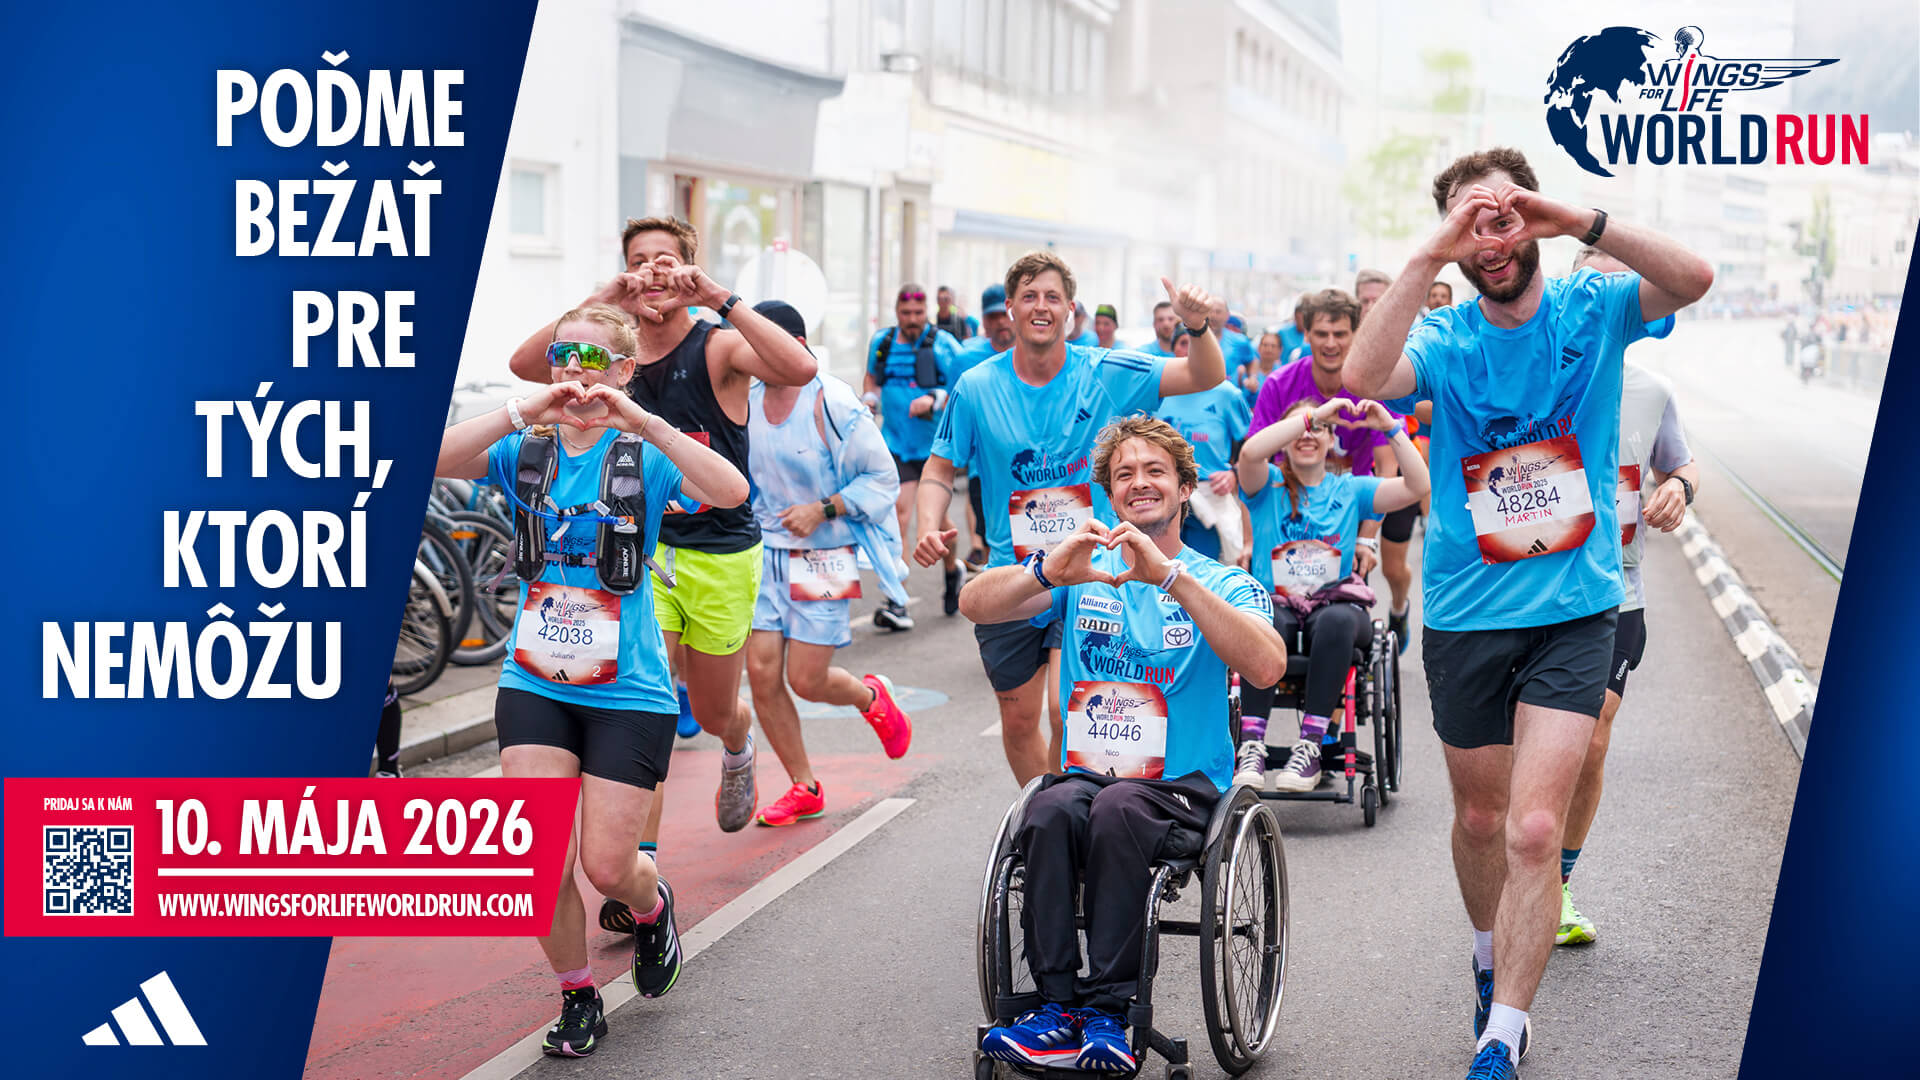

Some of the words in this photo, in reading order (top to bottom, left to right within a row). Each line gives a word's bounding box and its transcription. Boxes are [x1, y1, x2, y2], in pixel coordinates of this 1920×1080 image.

[1025, 465, 1067, 483] WORLD
[1066, 455, 1088, 476] RUN
[1506, 462, 1541, 476] WINGS
[1497, 486, 1561, 515] 48284
[1030, 517, 1076, 534] 46273
[1505, 508, 1553, 527] MARTIN
[806, 560, 845, 574] 47115
[1288, 564, 1327, 577] 42365
[1080, 597, 1109, 610] Allianz
[1079, 618, 1121, 634] RADO
[538, 625, 593, 645] 42038
[592, 665, 601, 678] 2
[1095, 655, 1144, 681] WORLD
[1144, 666, 1175, 685] RUN
[1104, 697, 1135, 707] WINGS
[1088, 722, 1142, 742] 44046
[1105, 748, 1120, 757] Nico
